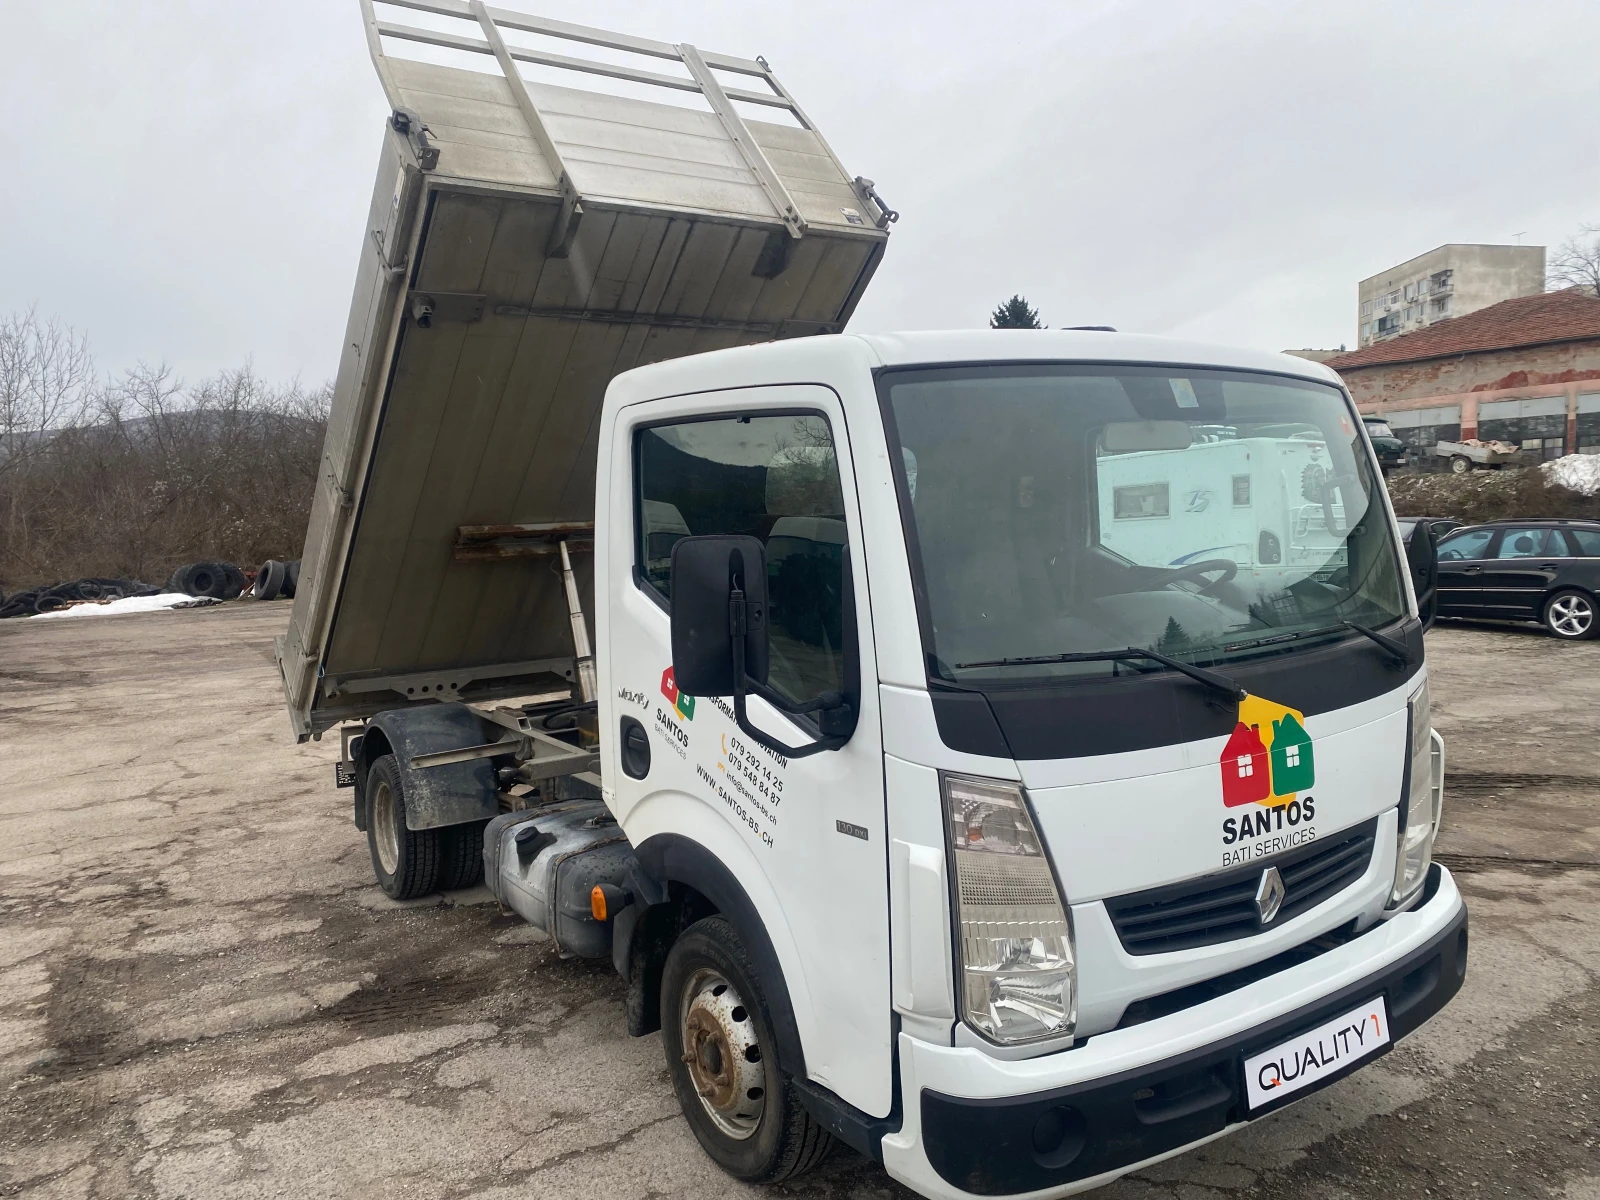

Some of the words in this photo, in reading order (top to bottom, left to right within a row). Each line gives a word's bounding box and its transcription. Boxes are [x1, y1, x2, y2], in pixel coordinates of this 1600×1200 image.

[654, 723, 664, 737] BATI
[664, 732, 687, 760] SERVICES
[656, 708, 689, 748] SANTOS
[728, 752, 742, 771] 079
[742, 767, 757, 786] 548
[758, 782, 769, 798] 84
[770, 793, 781, 807] 87
[730, 737, 745, 755] 079
[746, 751, 760, 772] 292
[762, 767, 771, 781] 14
[773, 776, 784, 793] 25
[696, 763, 774, 848] WWW.SANTOS-BS.CH
[726, 770, 778, 826] info@santos-bs.ch
[1222, 796, 1316, 845] SANTOS
[837, 821, 853, 834] 130
[1222, 847, 1251, 867] BATI
[1255, 826, 1316, 857] SERVICES
[1258, 1018, 1366, 1091] QUALITY
